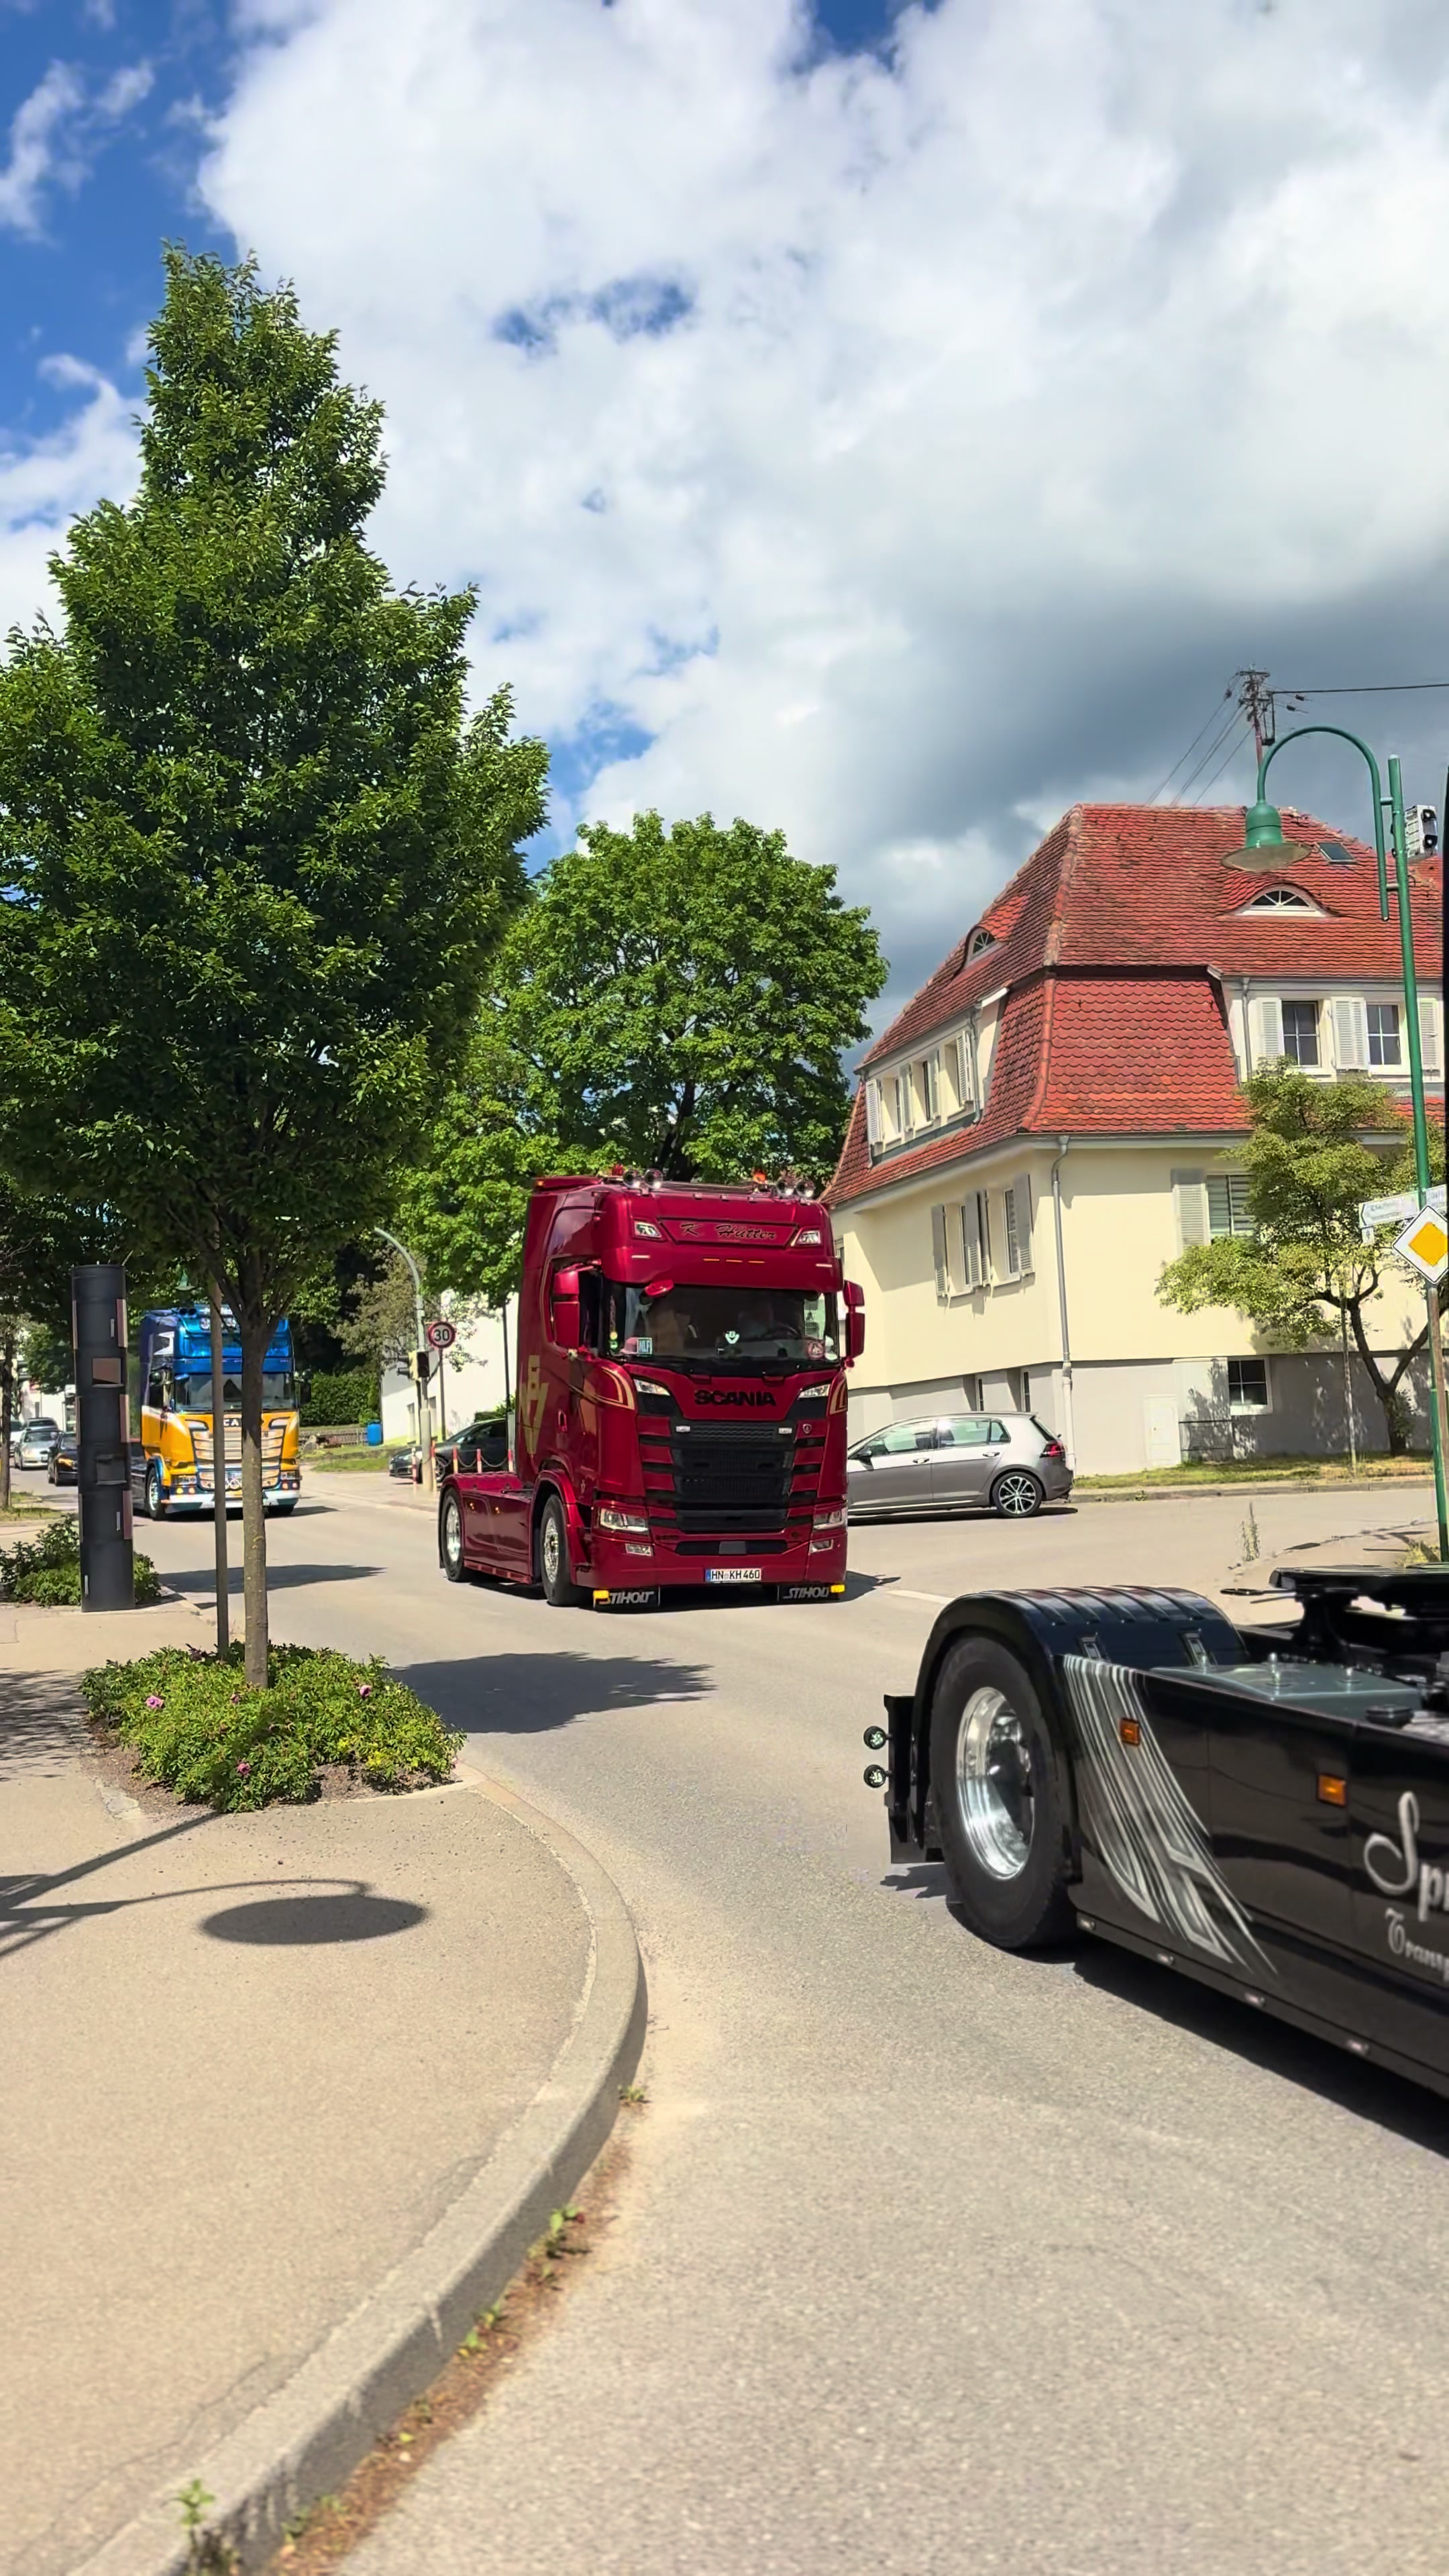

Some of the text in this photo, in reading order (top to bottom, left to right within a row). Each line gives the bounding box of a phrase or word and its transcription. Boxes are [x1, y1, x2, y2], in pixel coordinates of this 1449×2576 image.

[680, 1223, 702, 1237] K
[433, 1328, 450, 1342] 30
[694, 1389, 777, 1407] SCANIA
[711, 1570, 724, 1580] HN
